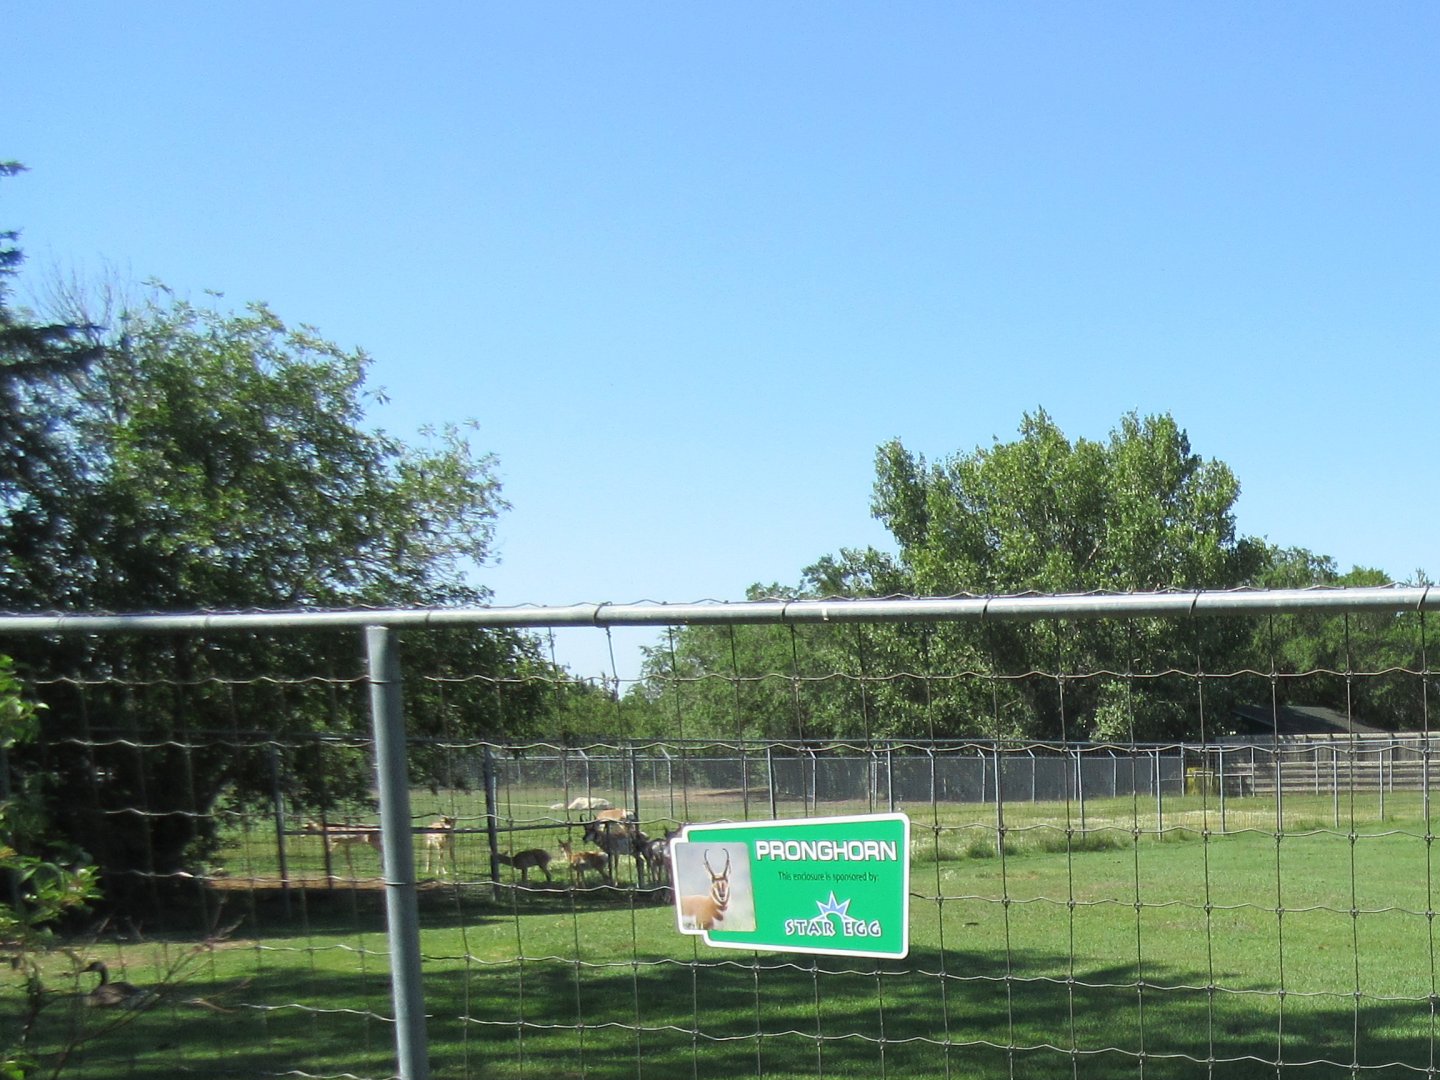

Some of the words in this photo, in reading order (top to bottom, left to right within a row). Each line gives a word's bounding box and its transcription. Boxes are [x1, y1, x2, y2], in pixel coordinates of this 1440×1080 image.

[755, 840, 898, 862] PRONGHORN
[778, 871, 792, 881] This
[793, 871, 825, 882] enclosure
[833, 871, 867, 883] sponsored
[785, 918, 836, 937] STAR
[844, 919, 882, 937] EGG
